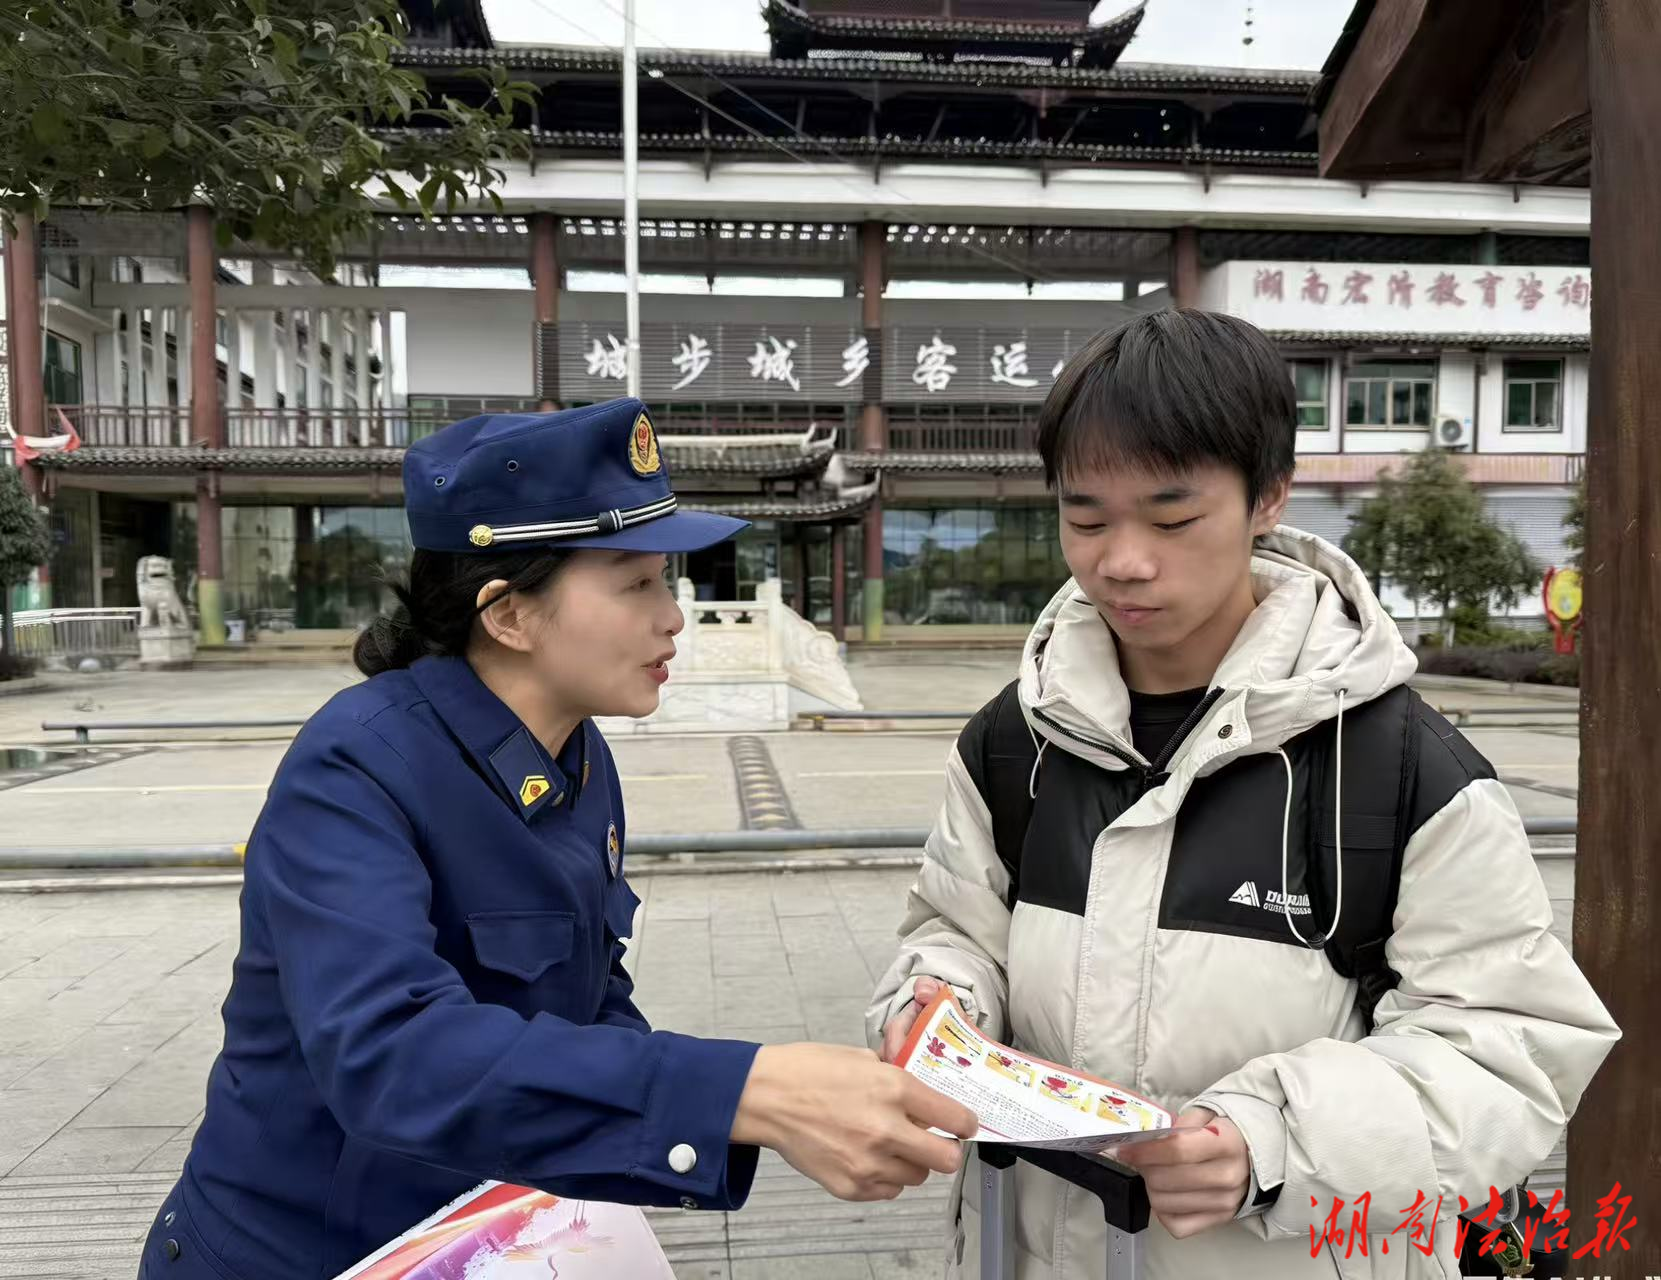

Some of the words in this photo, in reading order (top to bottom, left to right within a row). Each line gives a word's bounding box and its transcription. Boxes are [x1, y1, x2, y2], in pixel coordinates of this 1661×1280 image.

[583, 332, 1064, 393] 城步城乡客运
